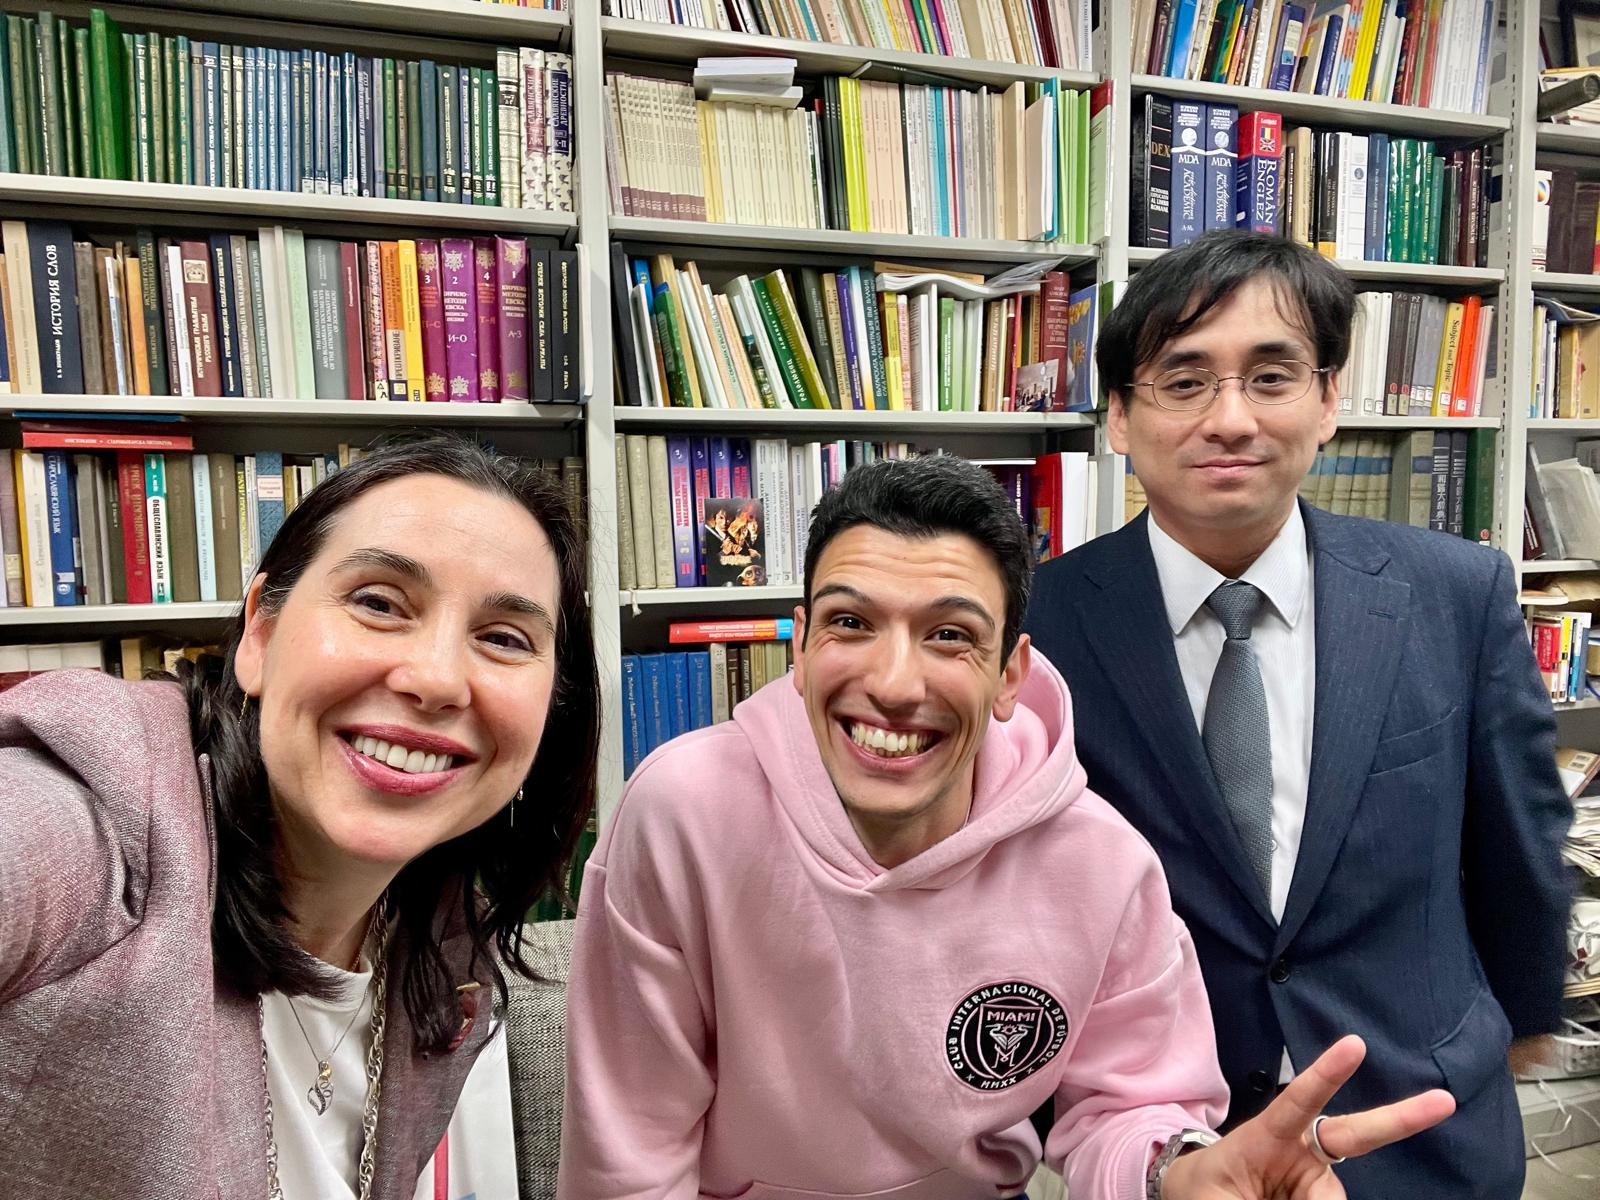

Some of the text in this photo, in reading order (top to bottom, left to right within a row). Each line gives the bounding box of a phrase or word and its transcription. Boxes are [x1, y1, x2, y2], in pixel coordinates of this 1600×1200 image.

[560, 81, 568, 126] ДРЕВНОСТИ
[1152, 141, 1170, 158] DEX
[1179, 154, 1199, 164] MDA
[1211, 158, 1232, 167] MDA
[1256, 159, 1267, 220] ENGLEZ
[1265, 159, 1277, 224] ROMÂN
[46, 245, 58, 276] СЛОВ
[512, 271, 516, 279] 1
[237, 266, 246, 306] МАКЕДОНСКИОТ
[425, 275, 431, 284] 3
[452, 277, 458, 285] 2
[483, 272, 490, 280] 4
[48, 280, 63, 335] ИСТОРИЯ
[190, 296, 204, 378] ИСТОРИЧЕСКАЯ ГРАММАТИКА
[772, 320, 786, 349] АЛМАНАХ
[868, 320, 877, 356] ЕМИГРАЦИЯ
[1448, 320, 1460, 348] Subject
[330, 362, 335, 370] OF
[877, 331, 886, 379] РУСКО-ТУРСКАТА
[872, 359, 882, 397] БЪЛГАРСКАТА
[1444, 363, 1453, 382] Topic
[48, 455, 61, 534] СТАРОСЛАВЯНСКИЙ ЯЗЫК
[153, 499, 164, 579] ОБЩЕСЛАВЯНСКИЙ ЯЗЫК
[948, 984, 1067, 1069] CLUB INTERNACIONAL DE FÚTBOL
[987, 1011, 1036, 1022] MIAMI
[981, 1076, 1016, 1089] MMXX
